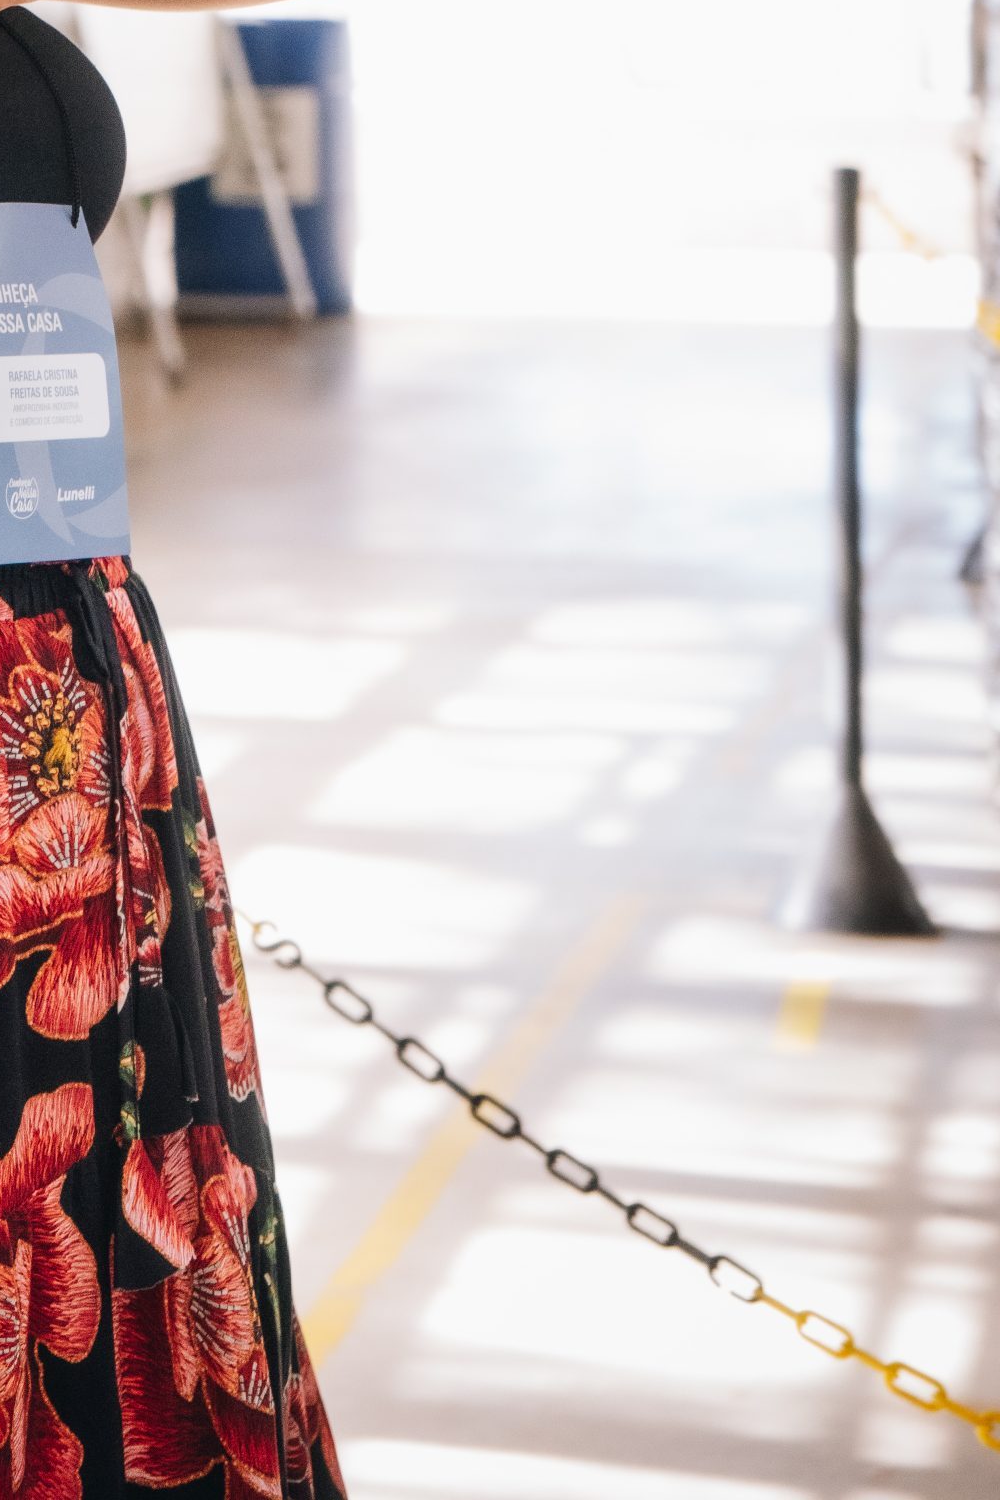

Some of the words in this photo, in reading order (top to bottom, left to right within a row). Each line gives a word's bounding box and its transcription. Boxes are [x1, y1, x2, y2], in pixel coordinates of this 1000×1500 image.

[27, 312, 63, 333] CASA
[8, 370, 42, 382] RAFAELA
[43, 368, 78, 381] CRISTINA
[10, 387, 41, 399] FREITAS
[42, 386, 53, 398] DE
[54, 385, 80, 397] SOUSA
[10, 491, 34, 513] Casa
[57, 485, 96, 503] Lunelli
